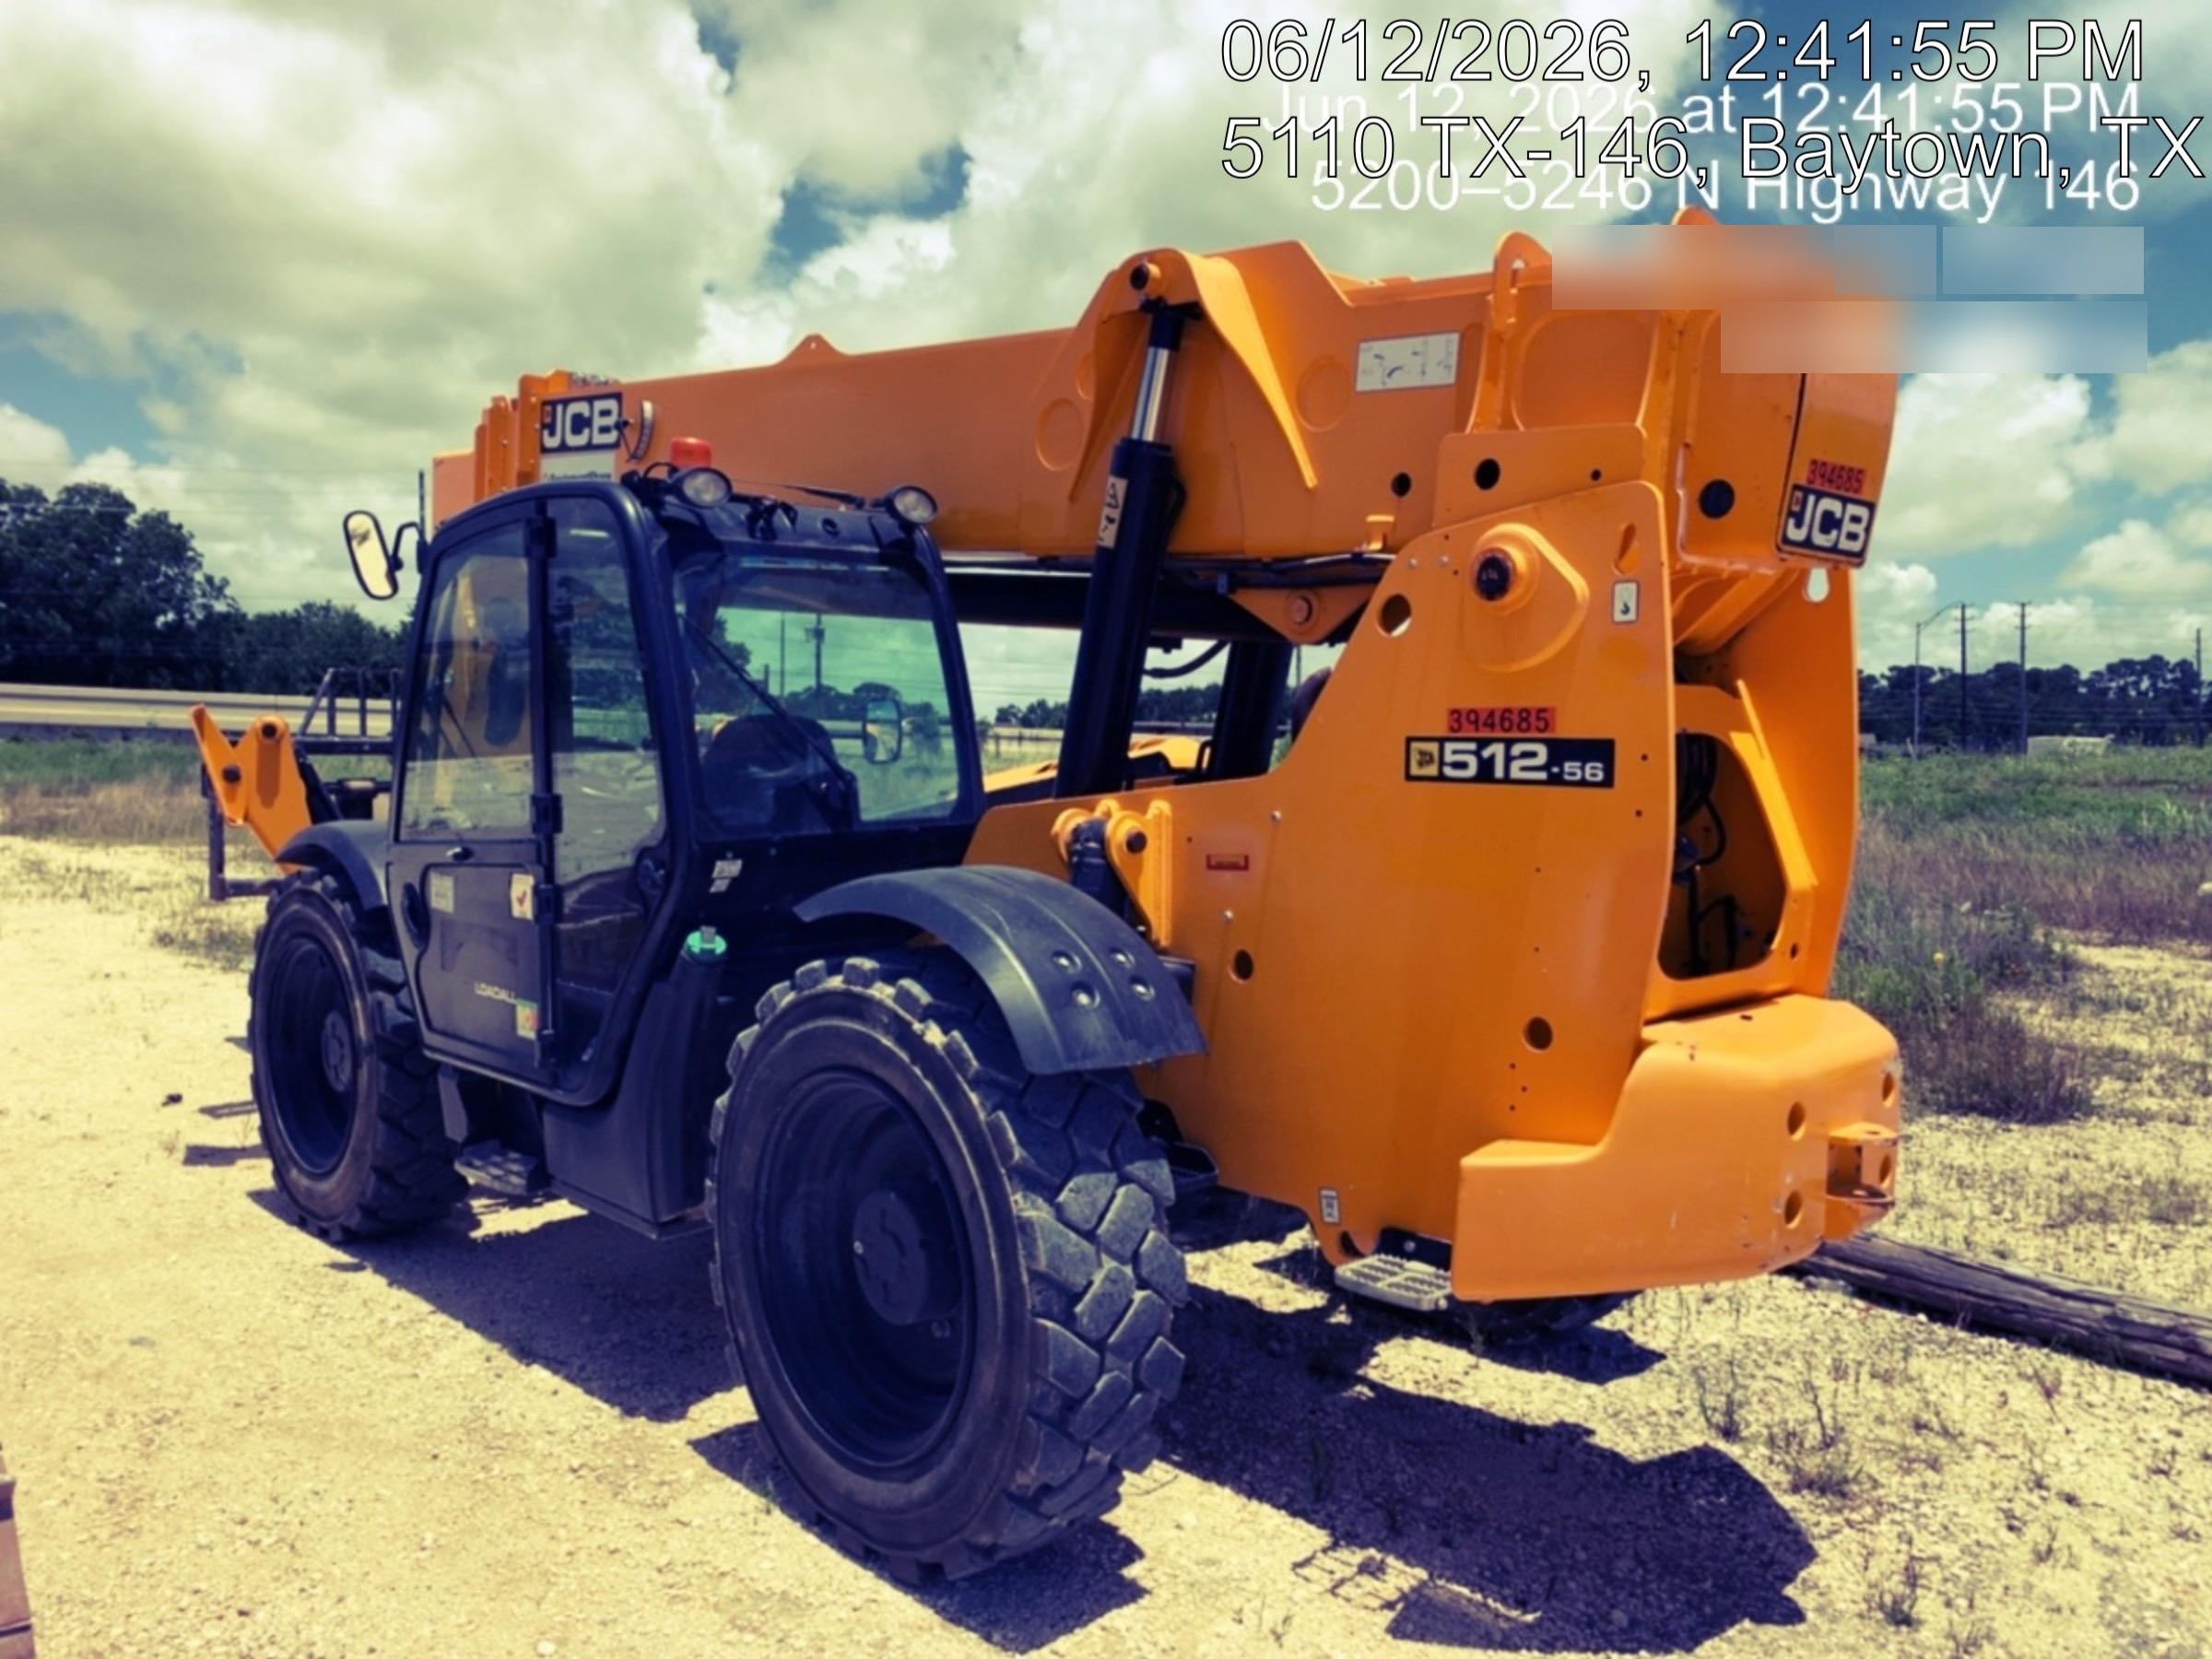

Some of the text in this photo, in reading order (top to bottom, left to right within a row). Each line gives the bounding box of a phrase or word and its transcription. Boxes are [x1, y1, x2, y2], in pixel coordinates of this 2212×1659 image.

[542, 398, 619, 450] JCB
[1786, 494, 1870, 553] JCB
[1448, 707, 1550, 735] 394685
